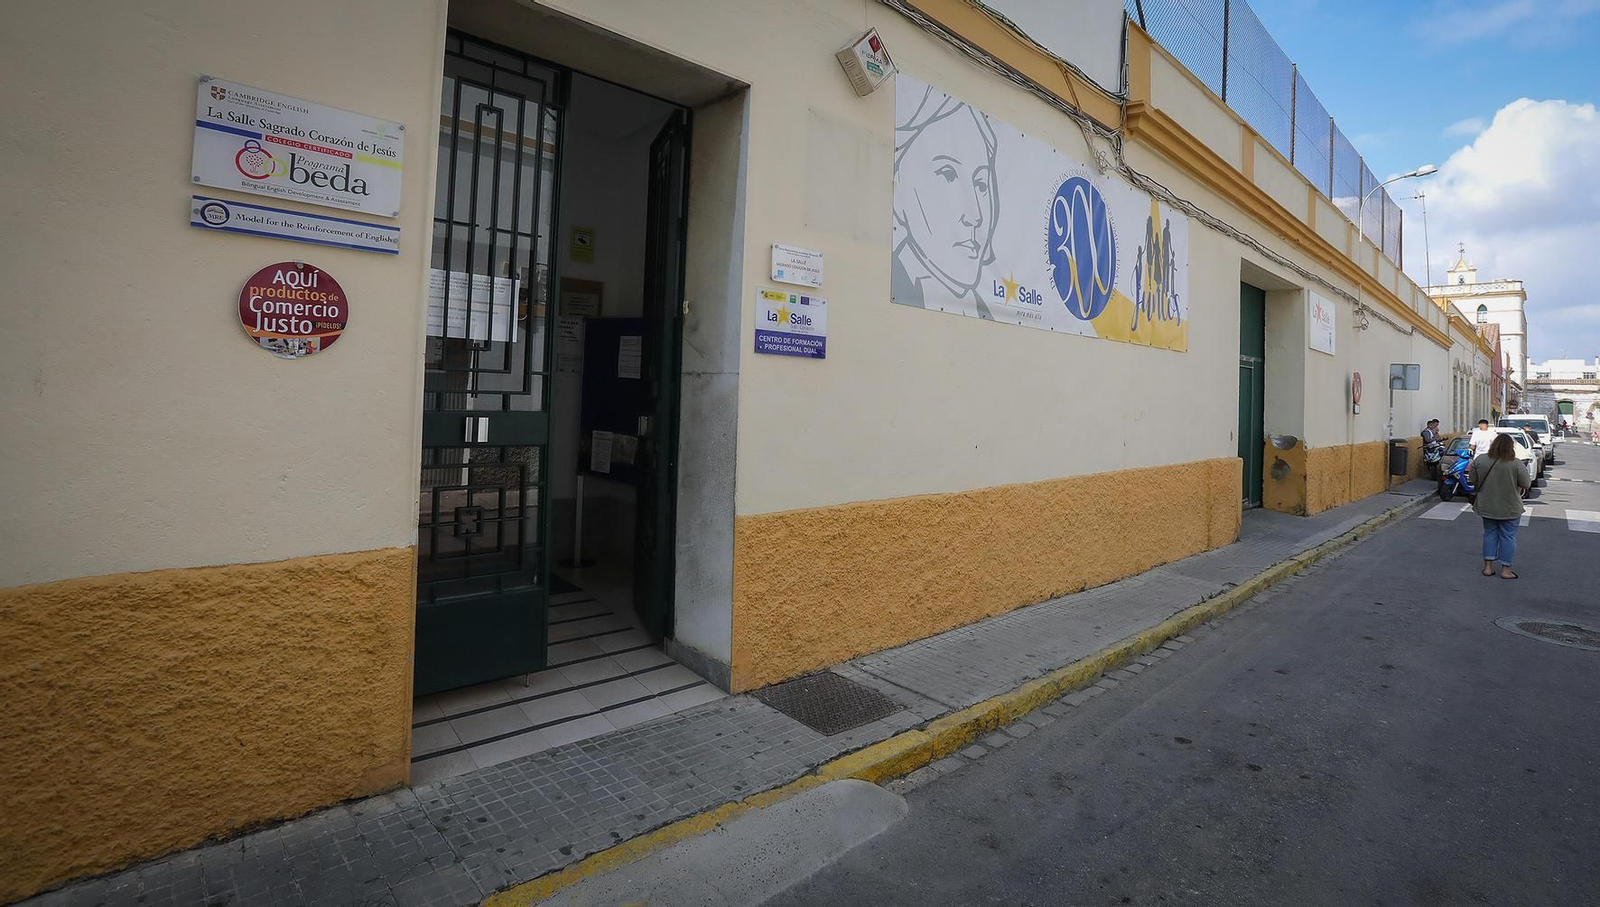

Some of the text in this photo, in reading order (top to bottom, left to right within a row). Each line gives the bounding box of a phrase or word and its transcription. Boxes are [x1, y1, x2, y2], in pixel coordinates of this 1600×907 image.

[228, 90, 275, 107] CAMBRIDGE
[277, 102, 309, 114] ENGLISH
[207, 106, 223, 119] La
[227, 110, 255, 126] Salle
[259, 118, 305, 138] Sagrado
[309, 129, 354, 148] Corazón
[357, 141, 369, 151] de
[372, 144, 397, 157] Jesús
[266, 136, 351, 158] COLEGIO CERTIFICADO
[289, 152, 371, 196] beda
[296, 155, 345, 173] Programa
[241, 181, 265, 190] Bilingual
[287, 189, 324, 200] Development
[330, 197, 361, 207] Assessment
[235, 213, 393, 243] Model for the Reinforcement of English
[272, 269, 320, 289] AQUÍ
[249, 285, 339, 302] productos de
[993, 280, 1043, 306] La Salle
[249, 295, 339, 318] Comercio
[767, 310, 812, 326] La Salle
[252, 311, 313, 334] Justo
[758, 335, 782, 344] CENTRO
[791, 338, 823, 348] FORMACIÓN
[764, 343, 803, 353] PROFESIONAL
